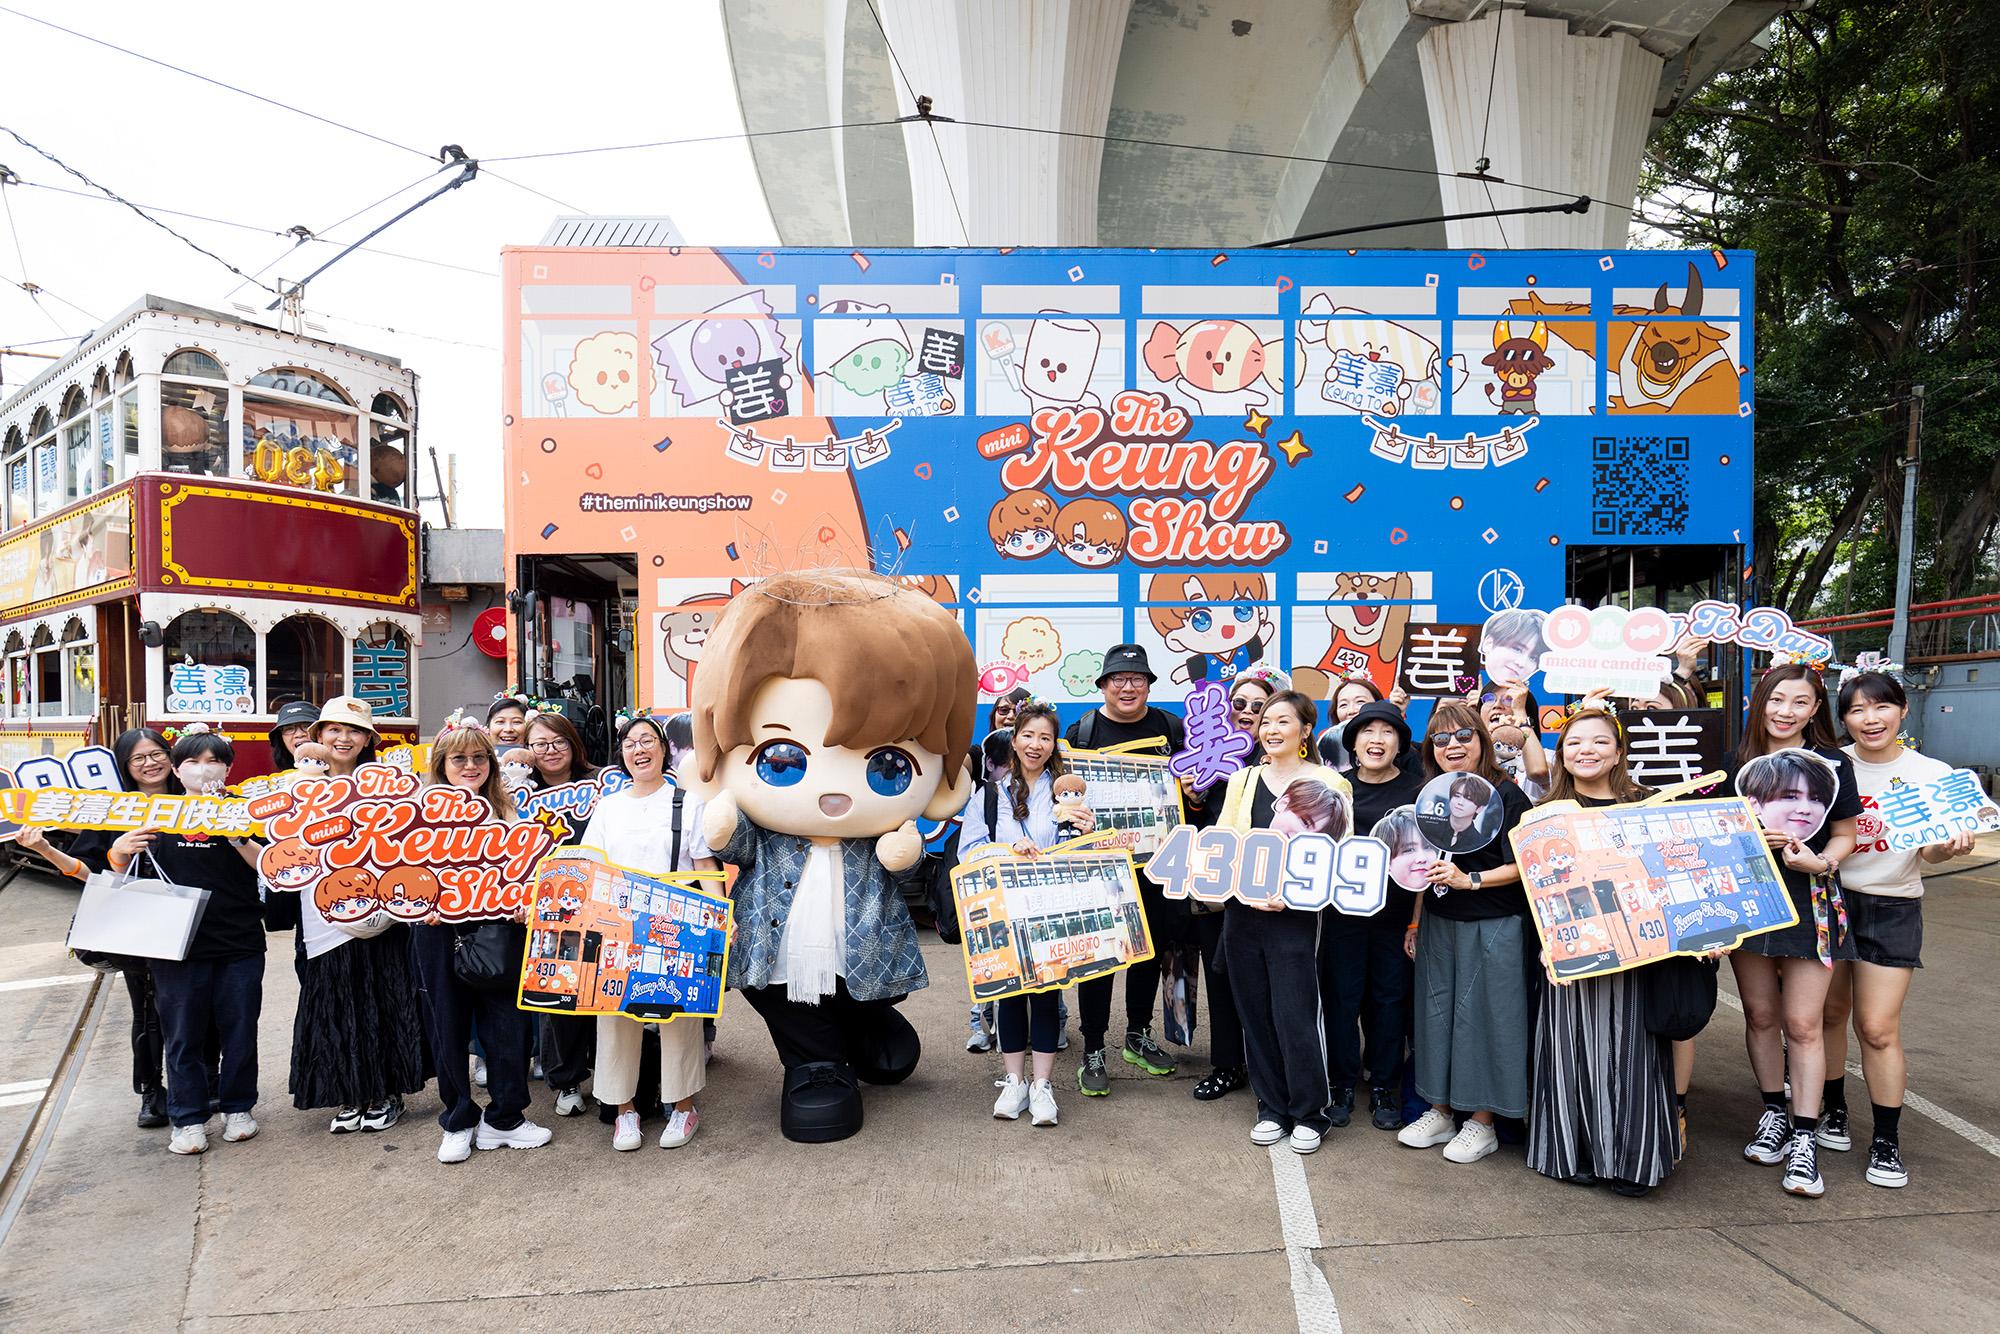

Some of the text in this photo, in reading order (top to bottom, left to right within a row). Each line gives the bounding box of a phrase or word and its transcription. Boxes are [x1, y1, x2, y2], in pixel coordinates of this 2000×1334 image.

[1326, 383, 1383, 411] Keung To
[1113, 393, 1186, 434] The
[984, 410, 1269, 520] mini Keung
[581, 494, 751, 514] #theminikeungshow
[1129, 499, 1284, 560] Show
[1692, 605, 1735, 637] To
[1741, 614, 1827, 660] Day
[1220, 664, 1237, 678] 99
[1339, 651, 1364, 669] 430
[1545, 655, 1665, 672] macau candies
[169, 697, 233, 713] Keung To
[1173, 687, 1249, 783] 姜
[356, 767, 415, 796] The
[602, 770, 635, 798] T
[29, 790, 252, 832] 姜濤生日快樂
[254, 793, 288, 816] mini
[423, 789, 482, 822] The
[1422, 800, 1445, 817] 26
[310, 818, 344, 842] mini
[328, 803, 546, 878] Keung
[1887, 822, 1952, 852] Keung
[1949, 815, 1979, 832] To
[567, 866, 588, 882] Day
[1672, 901, 1739, 936] Keung To Day
[1741, 899, 1760, 918] 99
[1557, 925, 1580, 942] 430
[1639, 919, 1665, 941] 430
[1049, 938, 1086, 960] KEUNG
[536, 963, 557, 977] 430
[602, 979, 623, 996] 430
[629, 976, 682, 1003] Keung To Day
[687, 986, 699, 1001] 99
